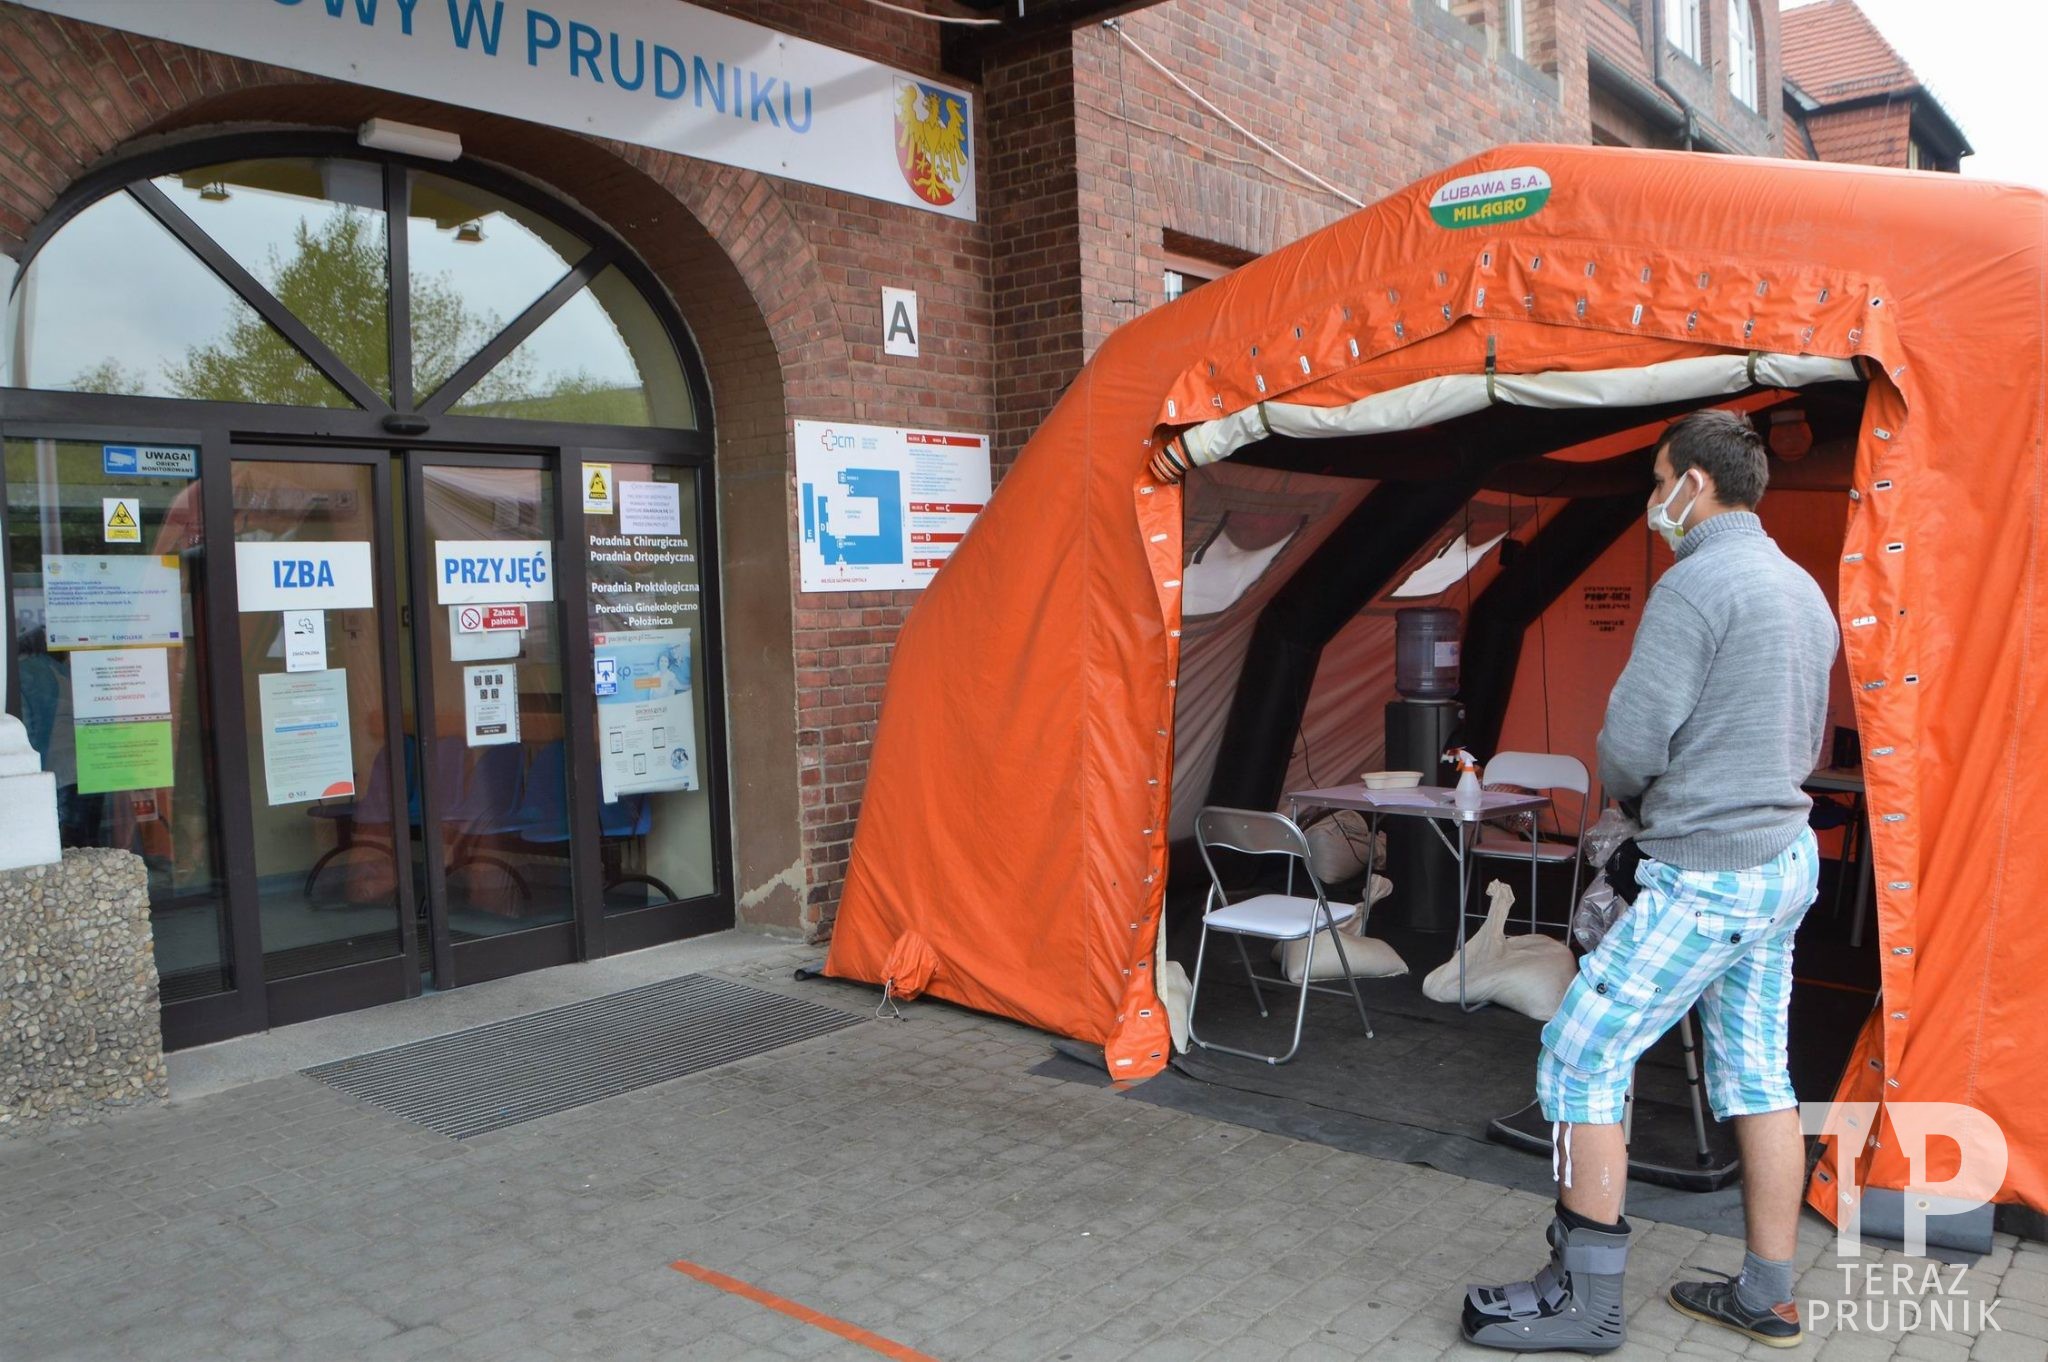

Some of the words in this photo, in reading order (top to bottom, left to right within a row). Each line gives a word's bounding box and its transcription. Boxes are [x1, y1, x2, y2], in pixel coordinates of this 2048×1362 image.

[526, 9, 812, 134] PRUDNIKU
[1441, 180, 1506, 202] LUBAWA
[1510, 175, 1543, 190] S.A.
[1453, 197, 1527, 222] MILAGRO
[888, 300, 916, 344] A
[145, 451, 191, 461] UWAGA!
[589, 535, 631, 546] Poradnia
[633, 536, 688, 549] Chirurgiczna
[590, 551, 632, 561] Poradnia
[633, 552, 695, 564] Ortopedyczna
[273, 560, 334, 588] IZBA
[444, 551, 546, 588] PRZYJĘĆ
[591, 581, 633, 592] Poradnia
[635, 582, 699, 594] Proktologiczna
[492, 608, 515, 617] Zakaz
[595, 603, 634, 613] Poradnia
[635, 602, 698, 613] Ginekologiczno
[491, 618, 518, 626] palenia
